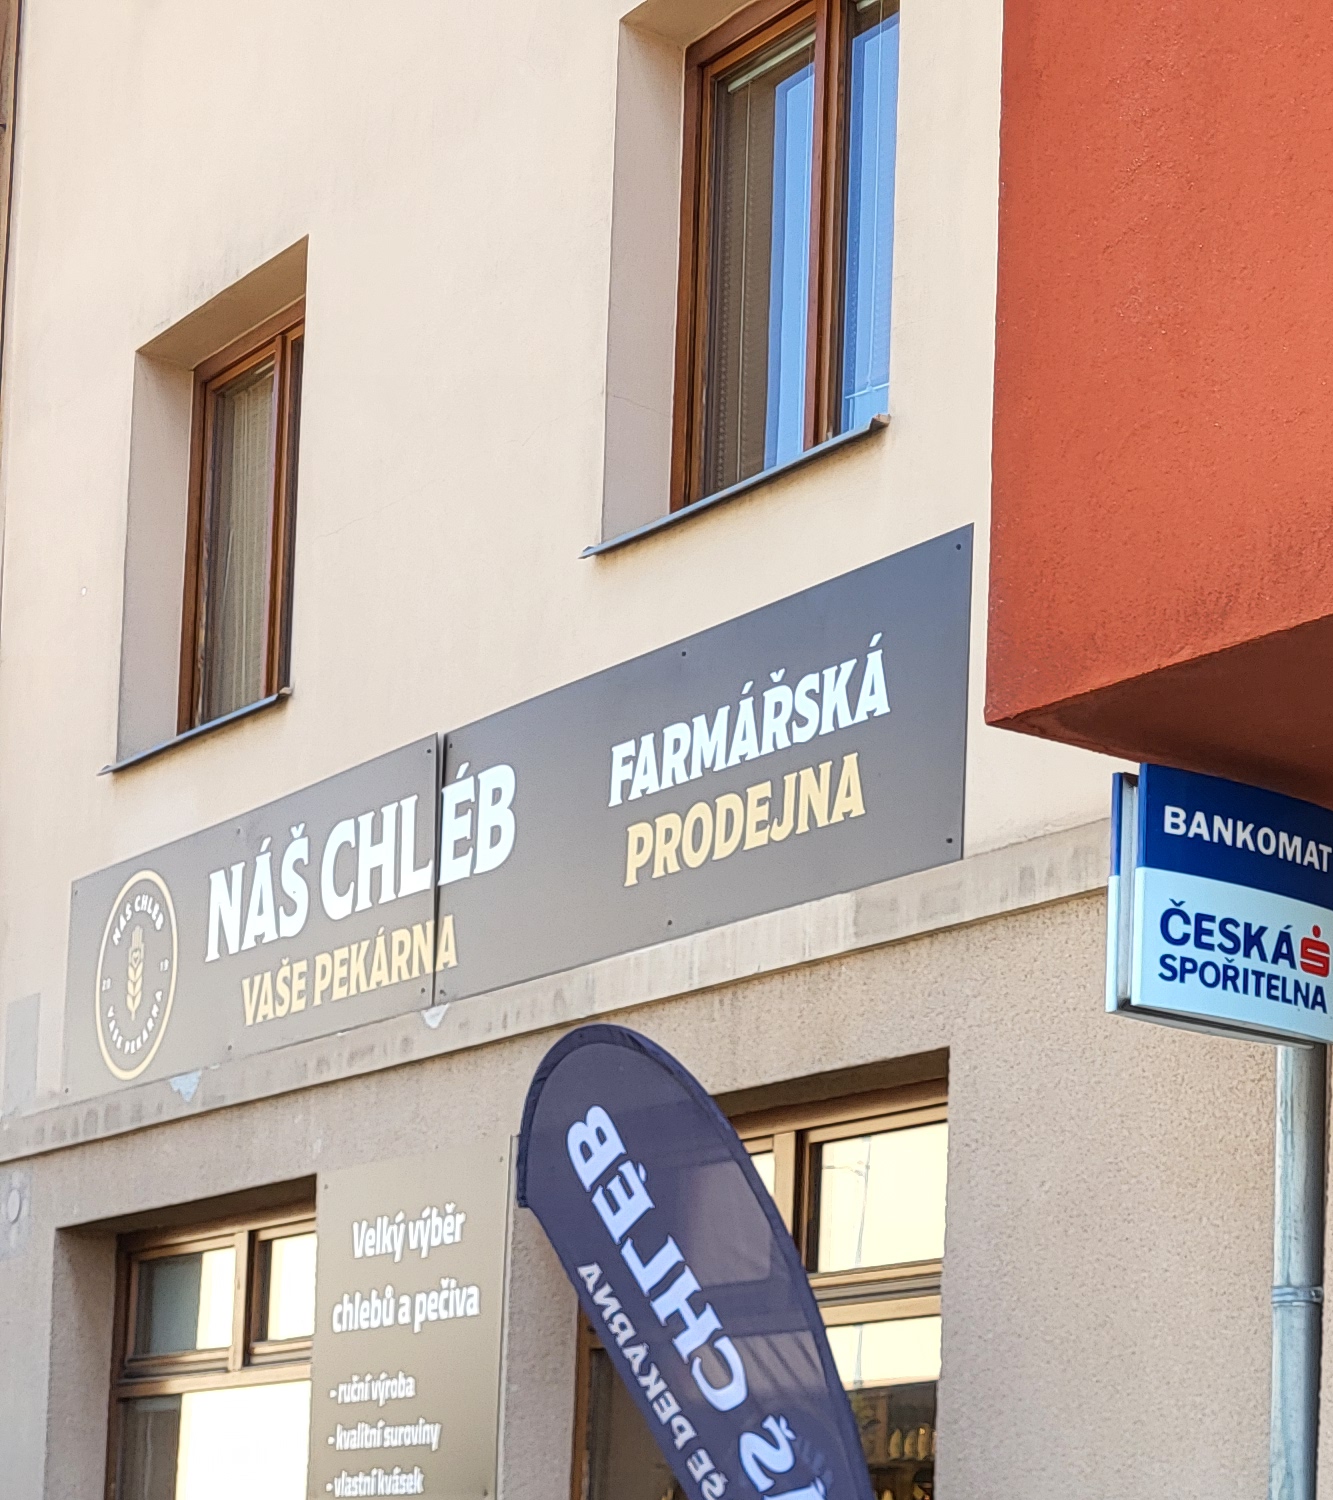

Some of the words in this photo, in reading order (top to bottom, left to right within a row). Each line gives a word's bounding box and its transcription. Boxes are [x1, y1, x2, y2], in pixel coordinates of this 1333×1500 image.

[608, 632, 890, 808] FARMÁŘSKÁ
[624, 752, 866, 887] PRODEJNA
[1163, 805, 1333, 873] BANKOMAT
[205, 822, 309, 962] NÁŠ
[320, 762, 516, 921] CHLÉB
[1159, 898, 1297, 970] ČESKÁ
[241, 956, 307, 1026] VAŠE
[312, 914, 458, 1007] PEKÁRNA
[1158, 954, 1328, 1014] SPOŘITELNA
[353, 1210, 406, 1263] Velký
[408, 1202, 467, 1259] výběr
[332, 1284, 396, 1333] chlebů
[398, 1294, 412, 1325] a
[413, 1277, 481, 1334] pečiva
[337, 1374, 374, 1404] ruční
[372, 1370, 416, 1407] výroba
[336, 1419, 386, 1451] kvalitní
[383, 1417, 442, 1451] suroviny
[334, 1467, 379, 1497] vlastní
[377, 1465, 424, 1495] kvásek
